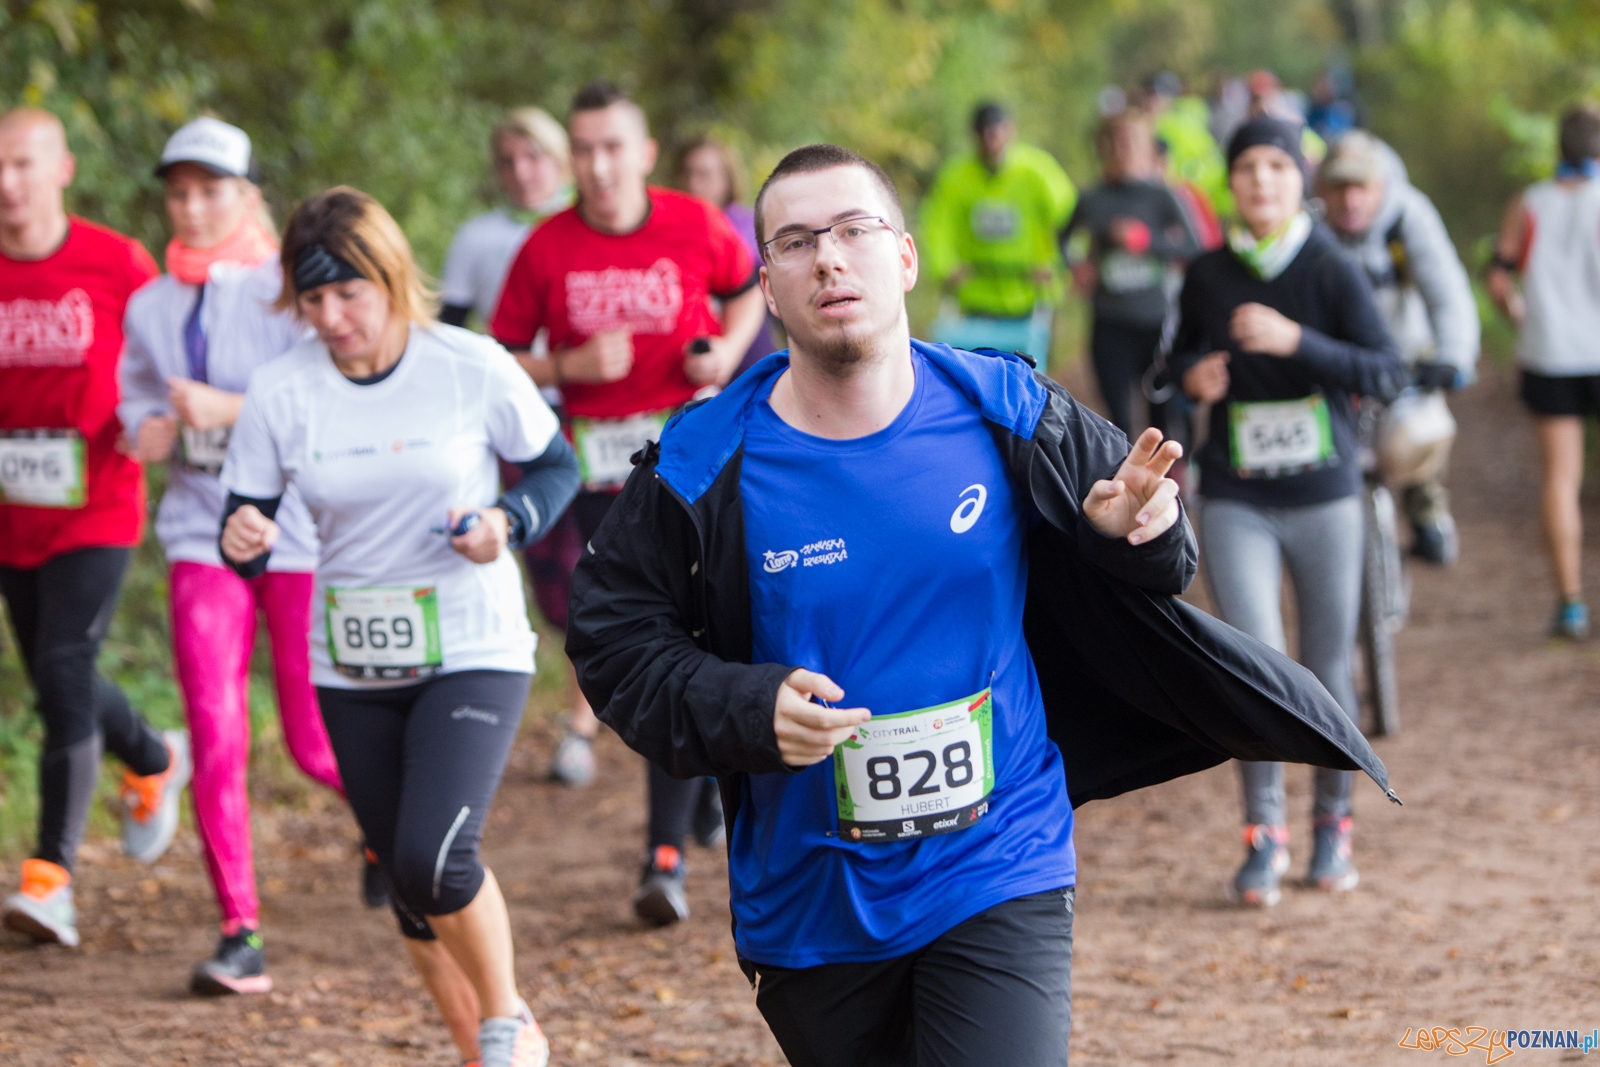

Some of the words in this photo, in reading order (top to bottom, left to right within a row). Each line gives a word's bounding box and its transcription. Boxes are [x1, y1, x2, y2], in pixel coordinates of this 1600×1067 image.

[344, 616, 413, 648] 869
[866, 740, 973, 801] 828
[901, 797, 951, 816] HUBERT
